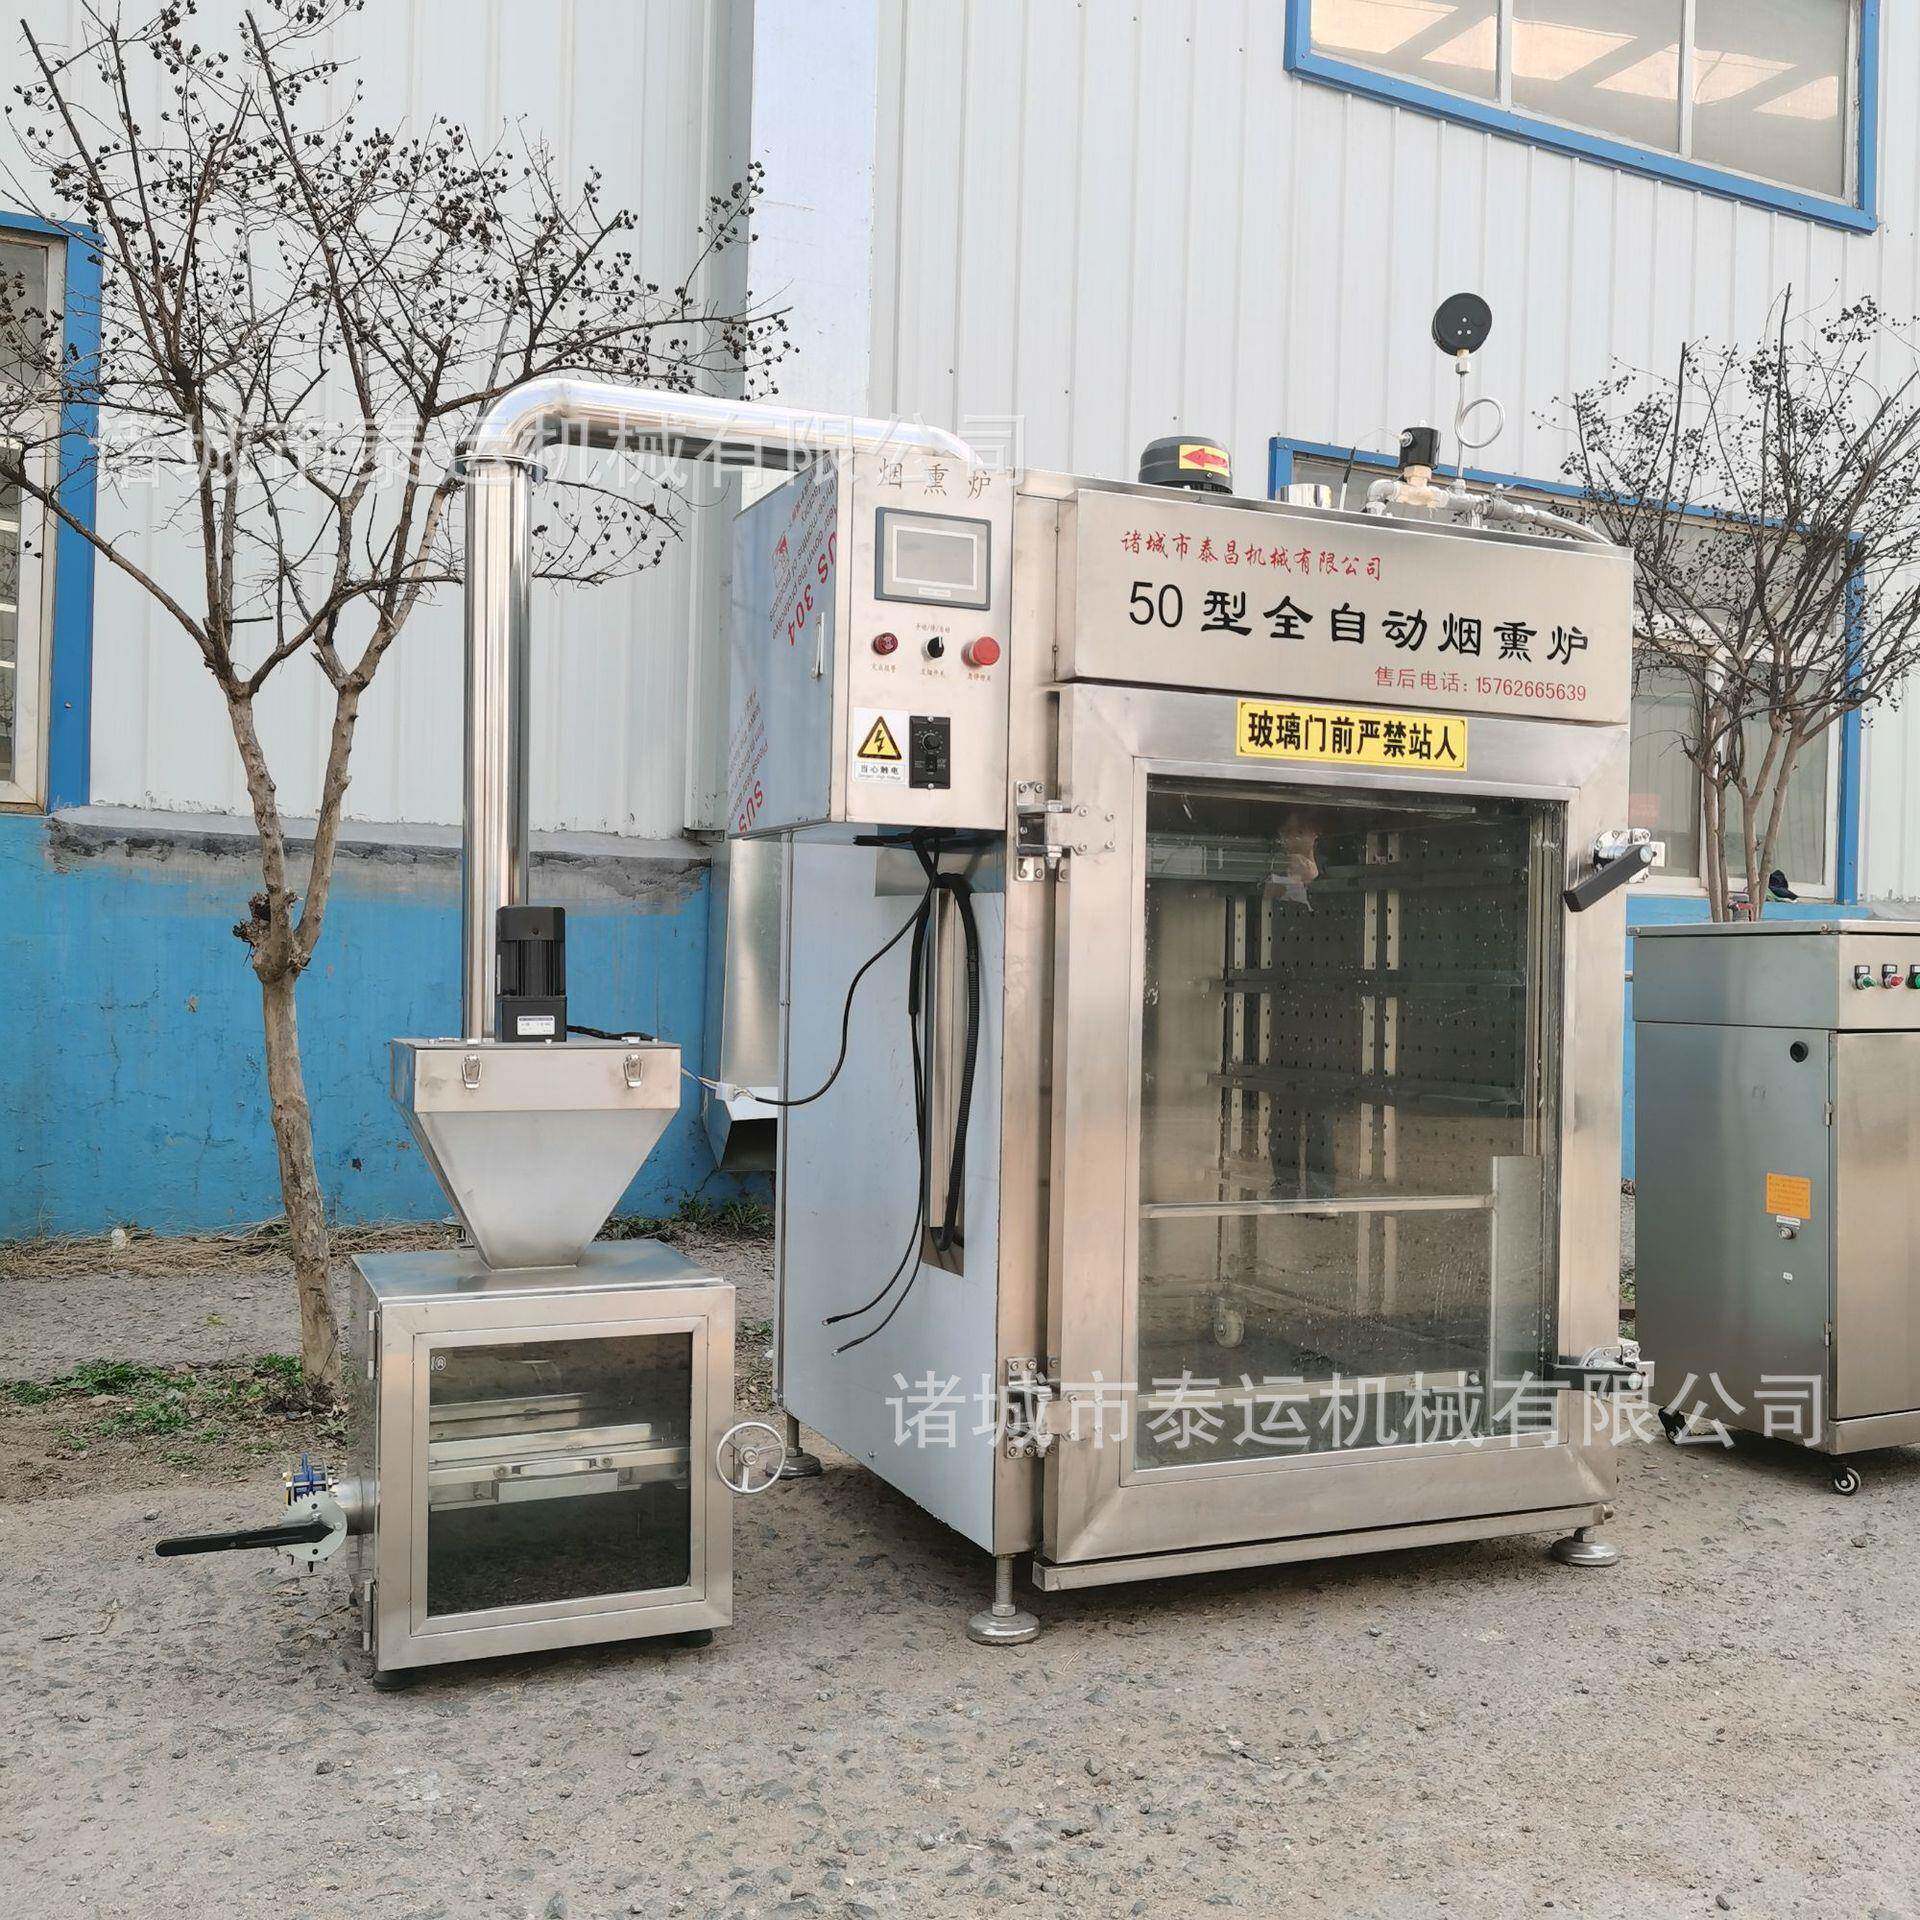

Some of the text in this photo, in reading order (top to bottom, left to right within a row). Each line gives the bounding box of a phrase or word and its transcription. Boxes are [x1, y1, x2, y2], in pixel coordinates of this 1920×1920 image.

[876, 457, 991, 500] 烟熏炉
[1121, 530, 1382, 581] 诸城市泰昌机械有限公司
[788, 583, 814, 647] 304
[1248, 709, 1457, 761] 玻璃门前严禁站人
